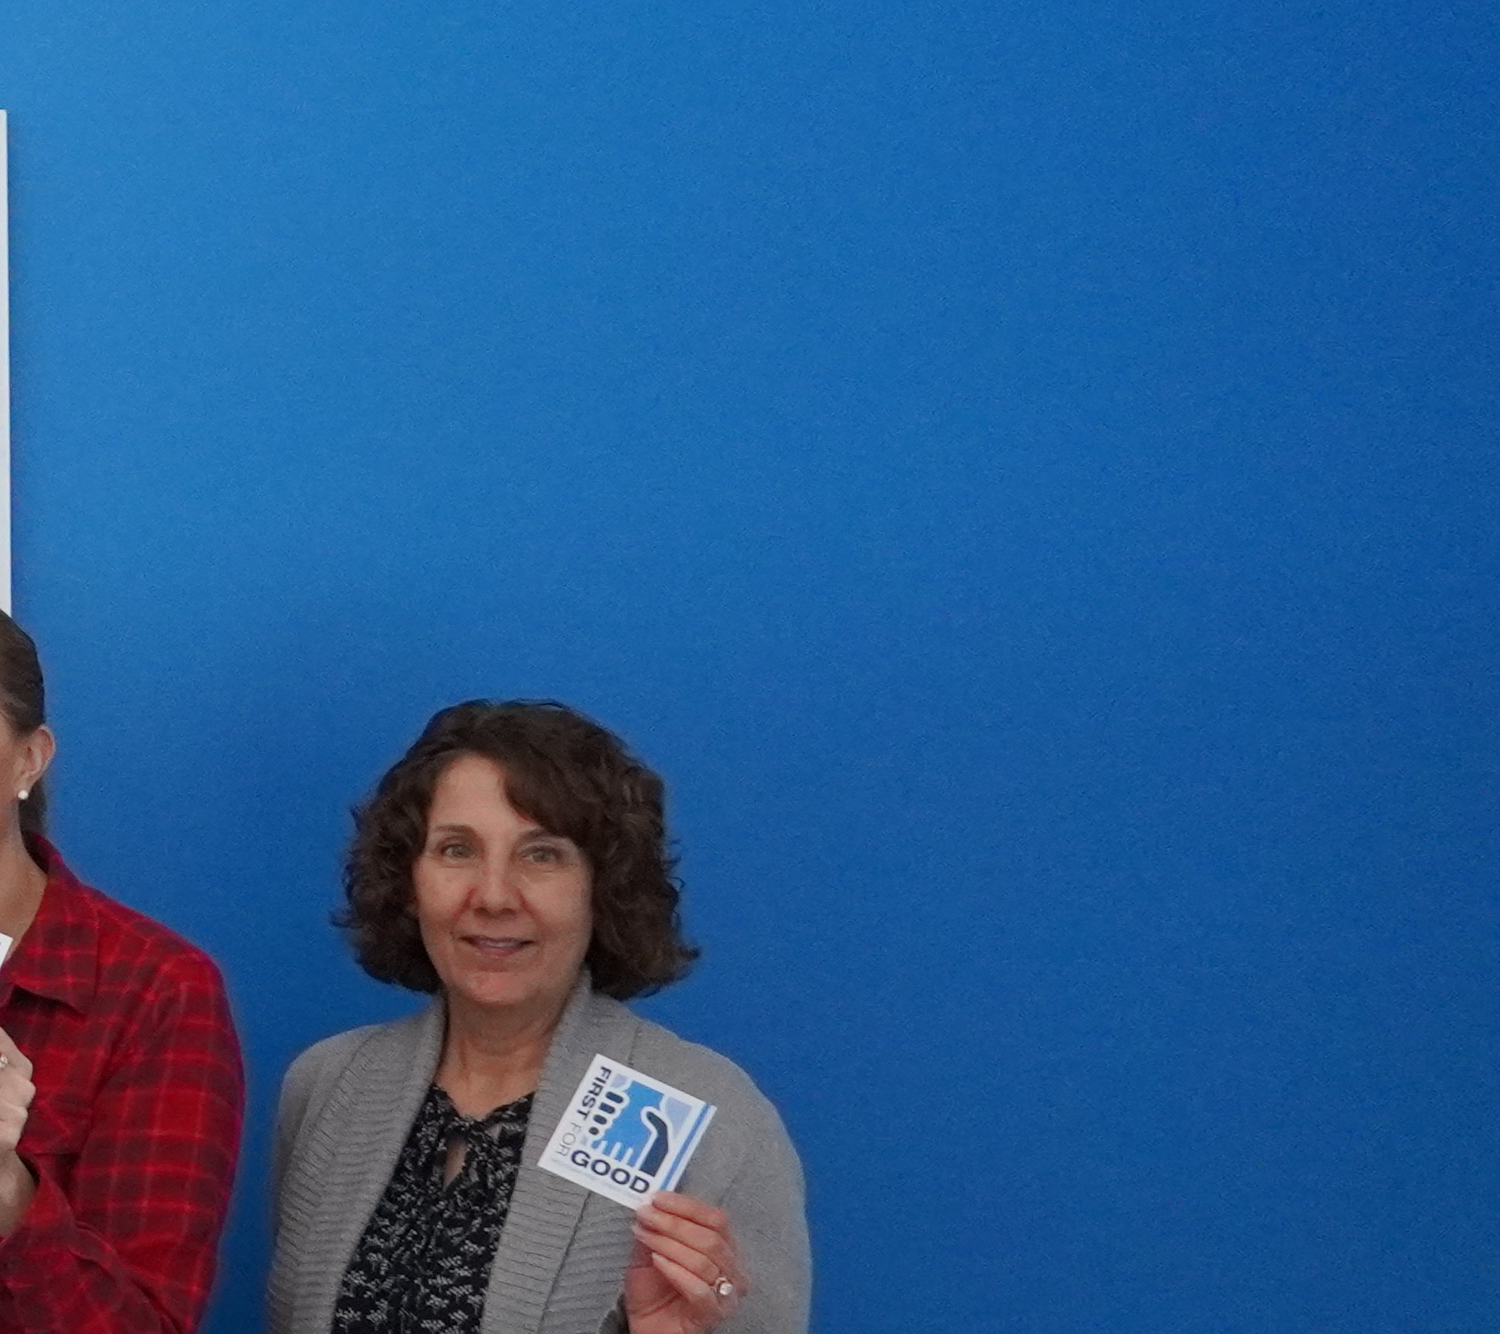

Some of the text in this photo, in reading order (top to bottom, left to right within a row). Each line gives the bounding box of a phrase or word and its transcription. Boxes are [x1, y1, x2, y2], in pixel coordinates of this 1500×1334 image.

[556, 1065, 612, 1157] FIRST FOR
[570, 1149, 650, 1194] GOOD
